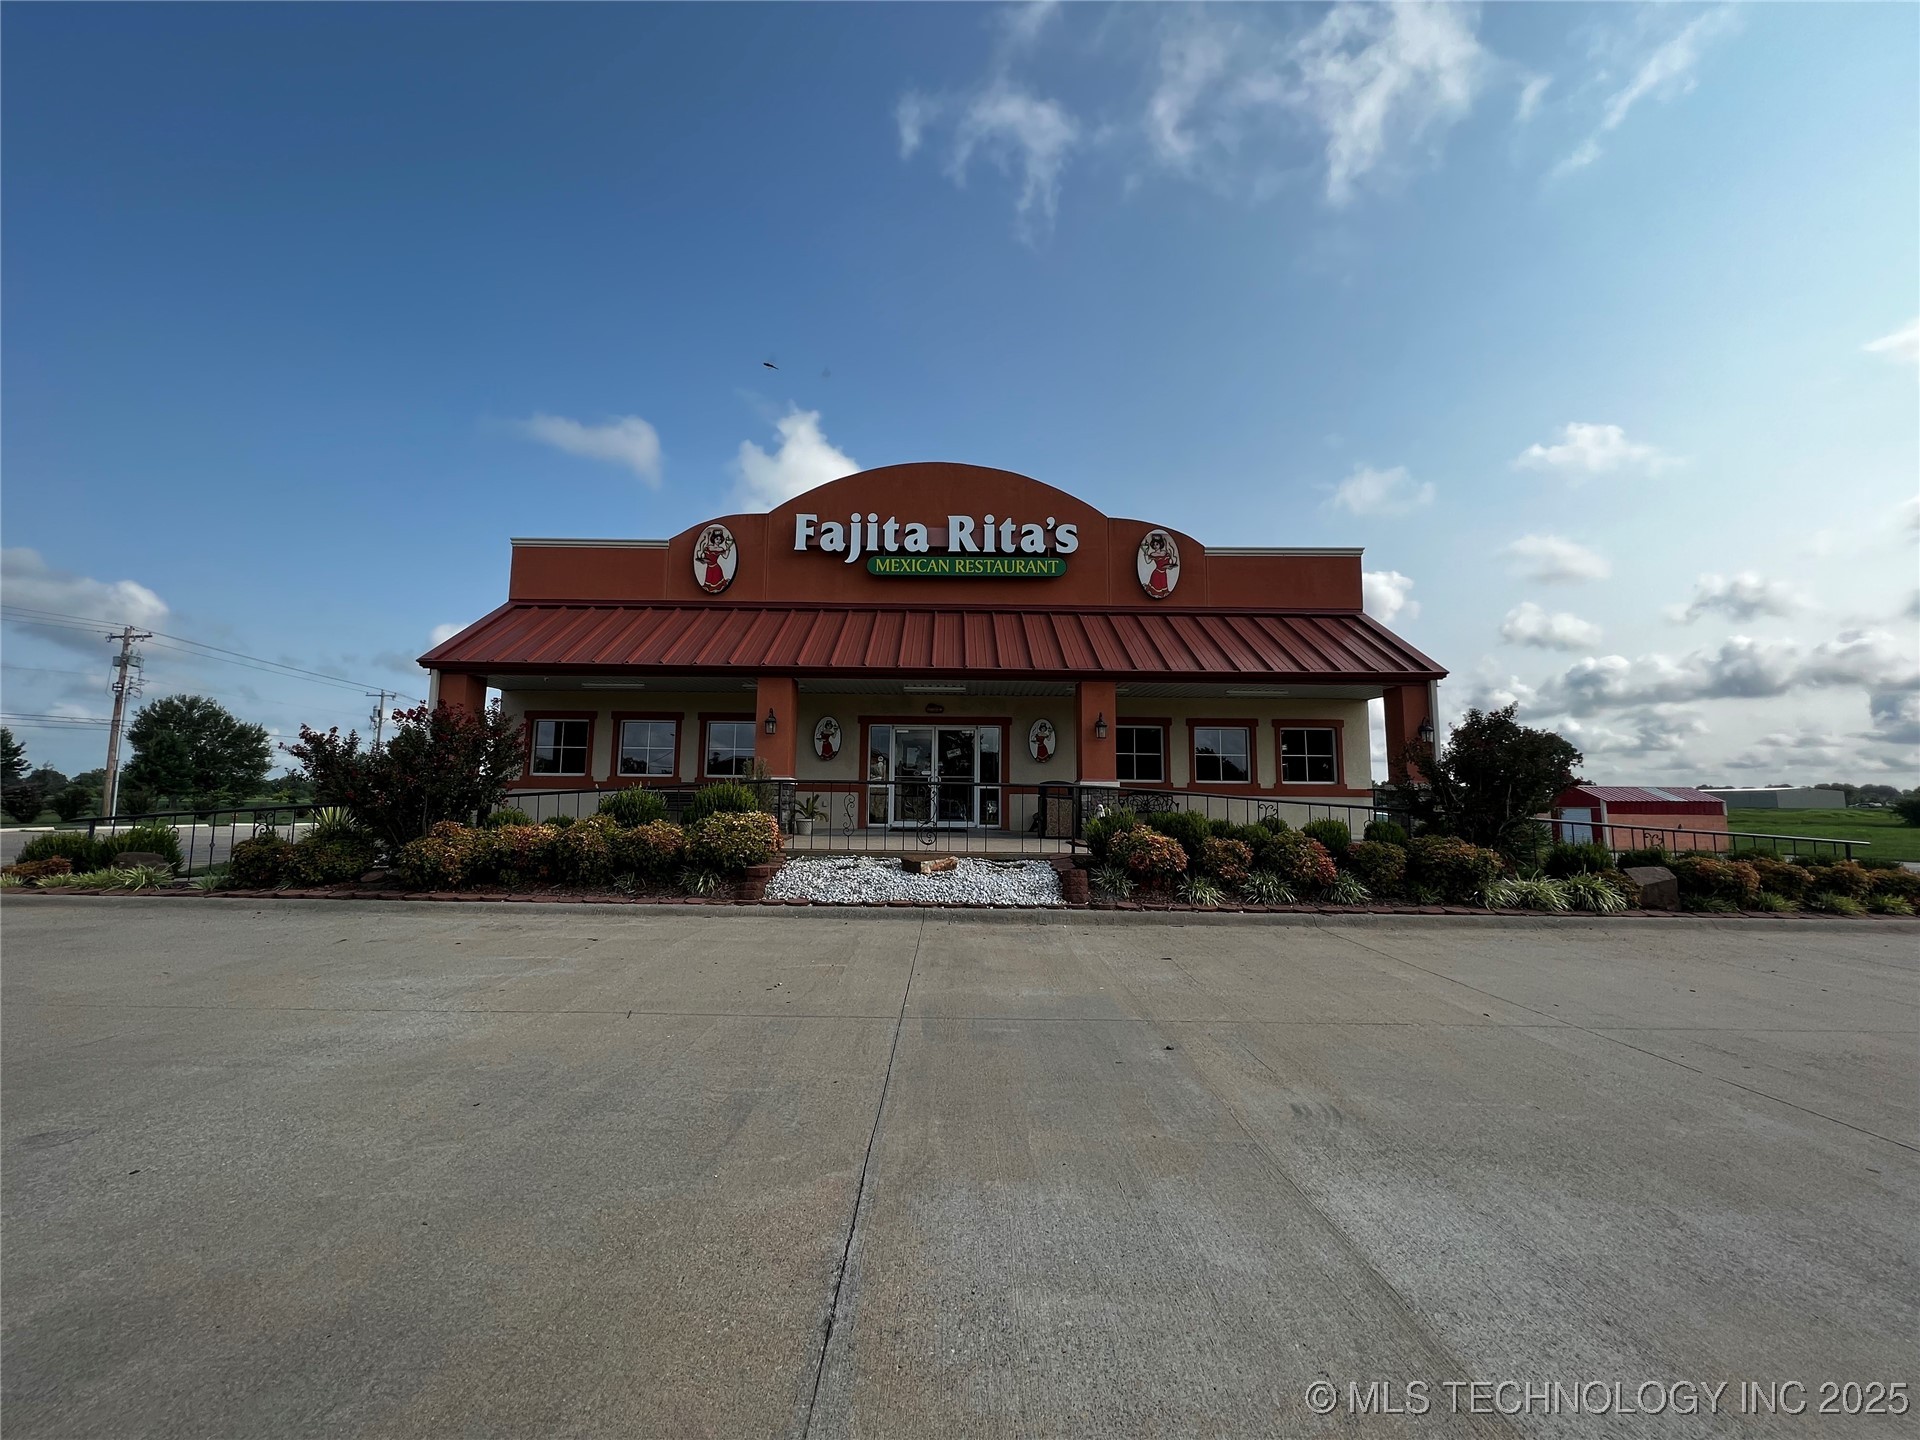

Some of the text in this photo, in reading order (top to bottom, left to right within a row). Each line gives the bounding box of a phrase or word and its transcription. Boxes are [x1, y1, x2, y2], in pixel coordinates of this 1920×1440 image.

[793, 512, 1079, 564] Fajita Rita's
[875, 558, 1059, 574] MEXICAN RESTAURANT
